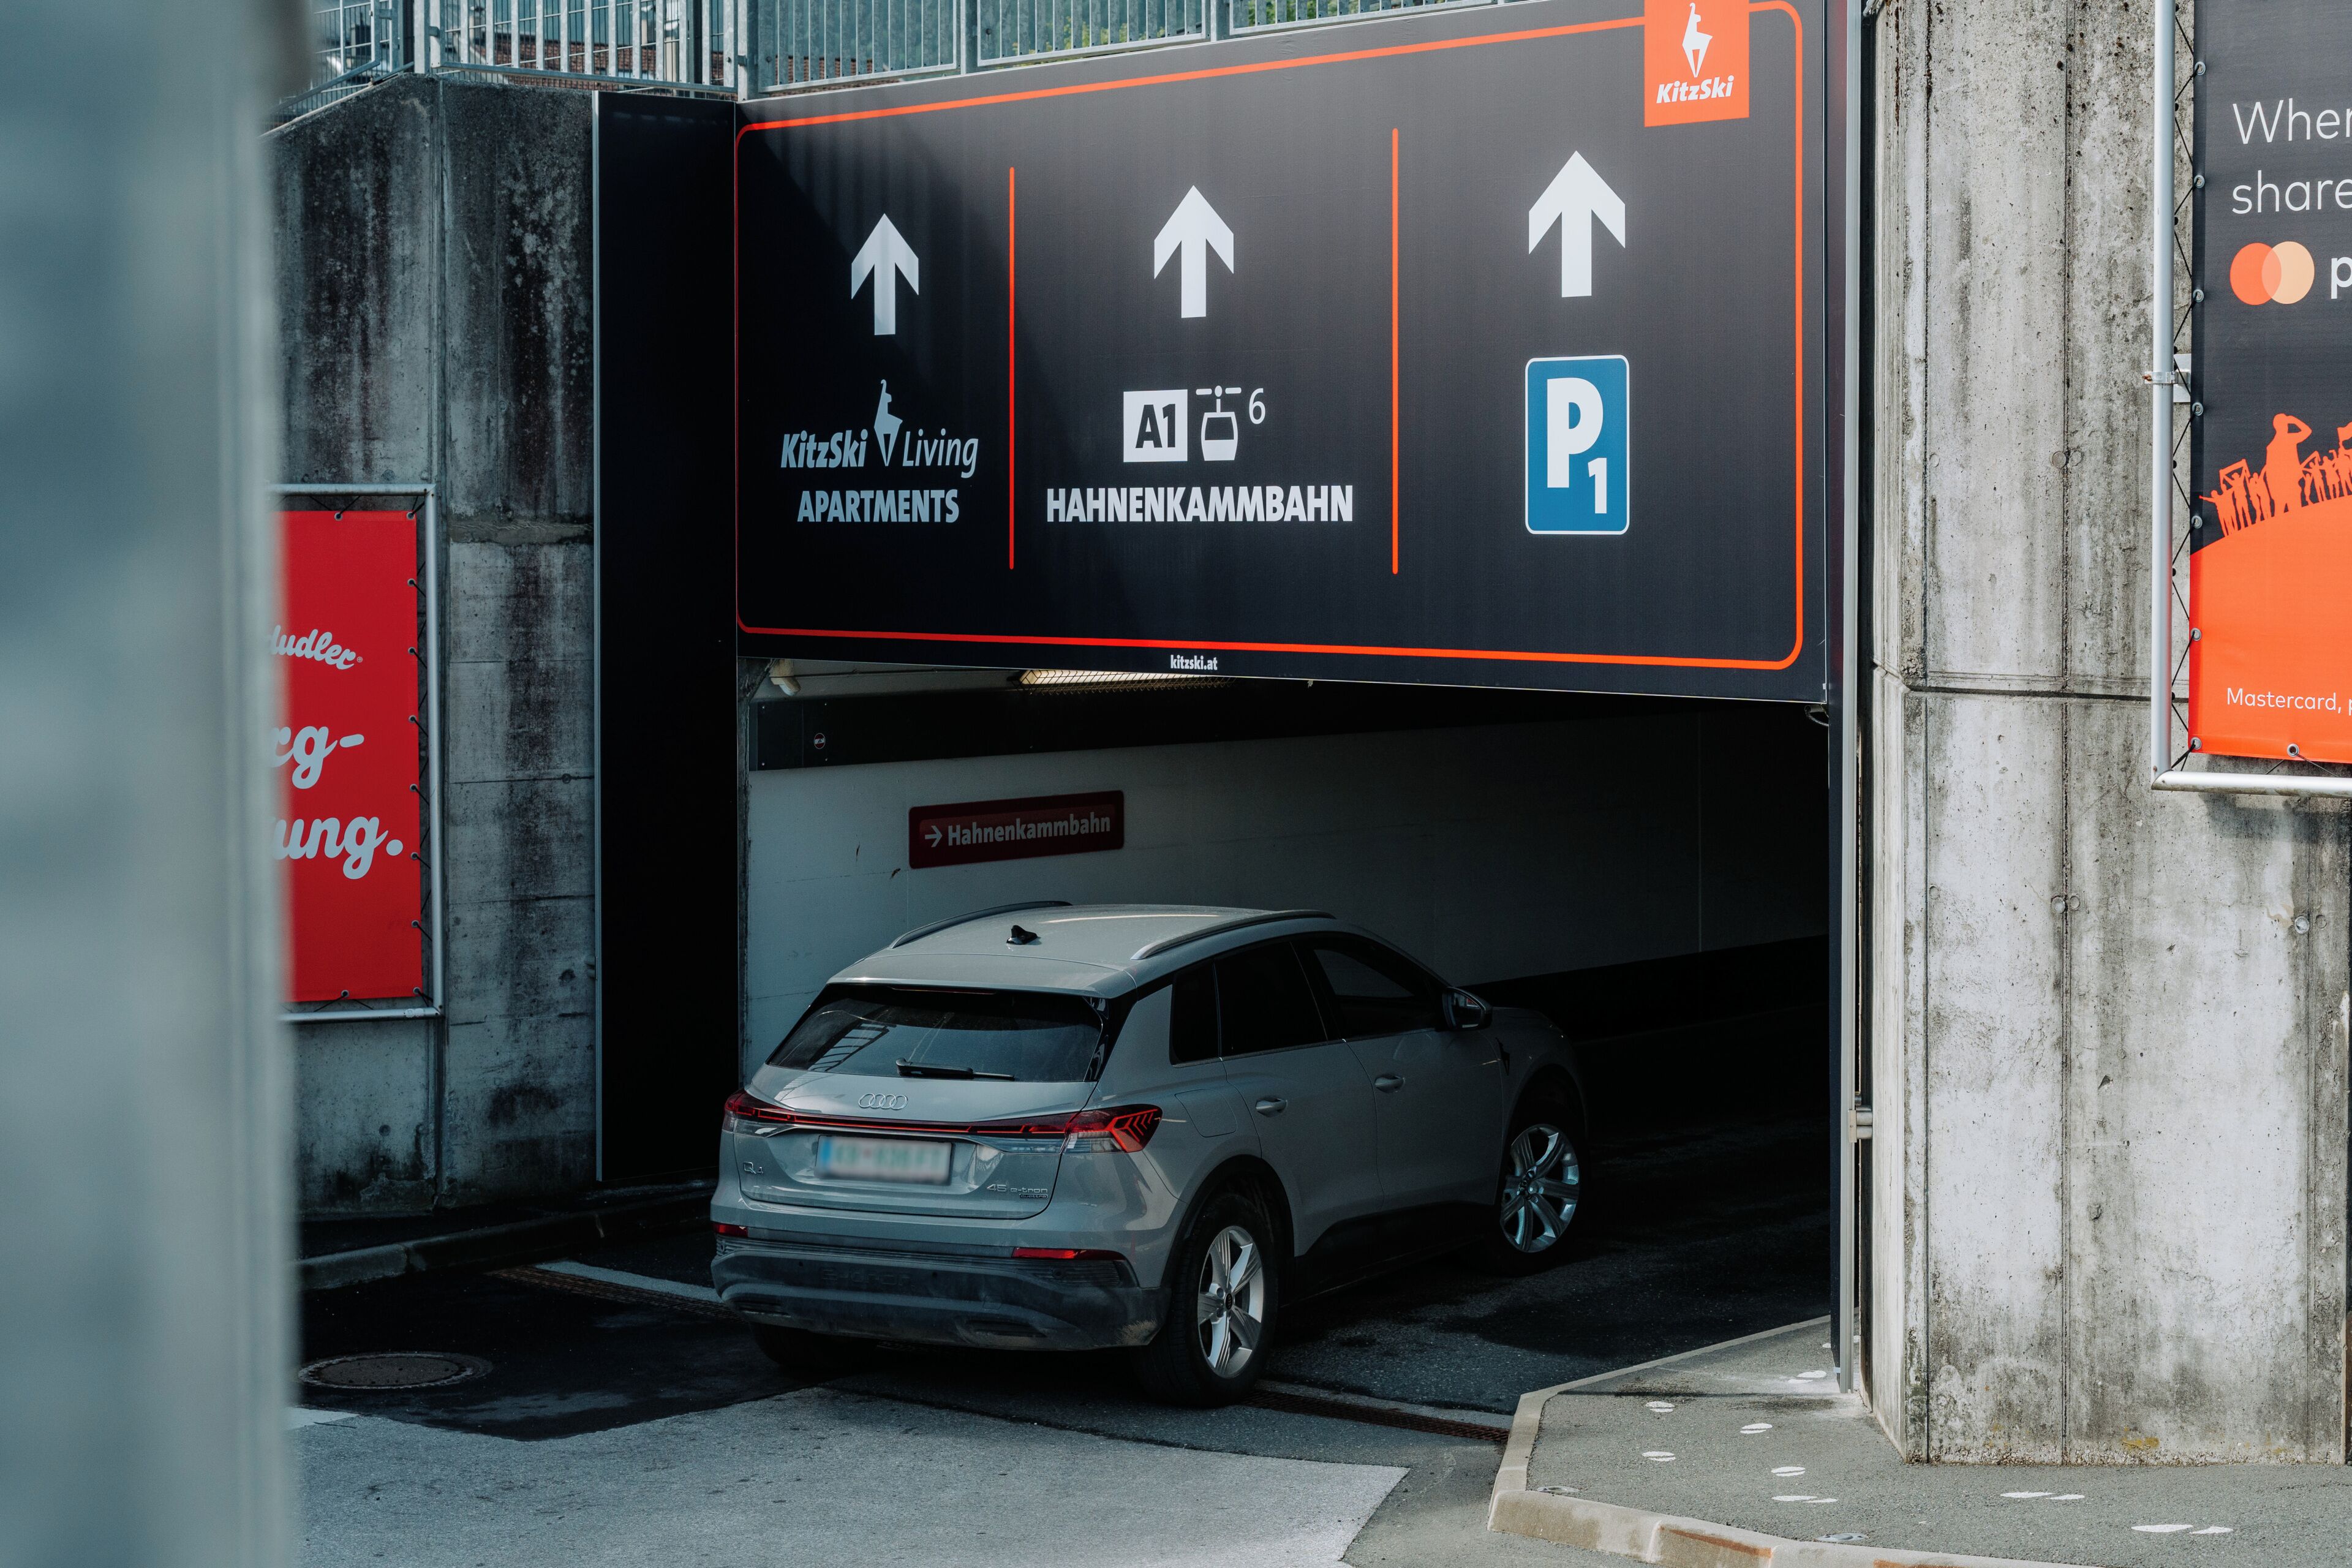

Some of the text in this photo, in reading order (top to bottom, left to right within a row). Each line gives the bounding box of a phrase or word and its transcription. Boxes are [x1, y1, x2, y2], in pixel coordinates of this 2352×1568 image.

[1656, 75, 1735, 104] KitzSki
[2232, 170, 2352, 214] share
[1135, 388, 1266, 448] A1 6
[780, 428, 979, 478] KitzSki Living
[797, 489, 960, 523] APARTMENTS
[1047, 485, 1353, 522] HAHNENKAMMBAHN
[1170, 654, 1218, 671] kitzski.at
[2227, 687, 2342, 714] Mastercard,
[948, 811, 1110, 846] Hahnenkammbahn
[270, 816, 404, 880] ung.
[743, 1161, 764, 1175] Q4
[986, 1183, 1007, 1193] 45
